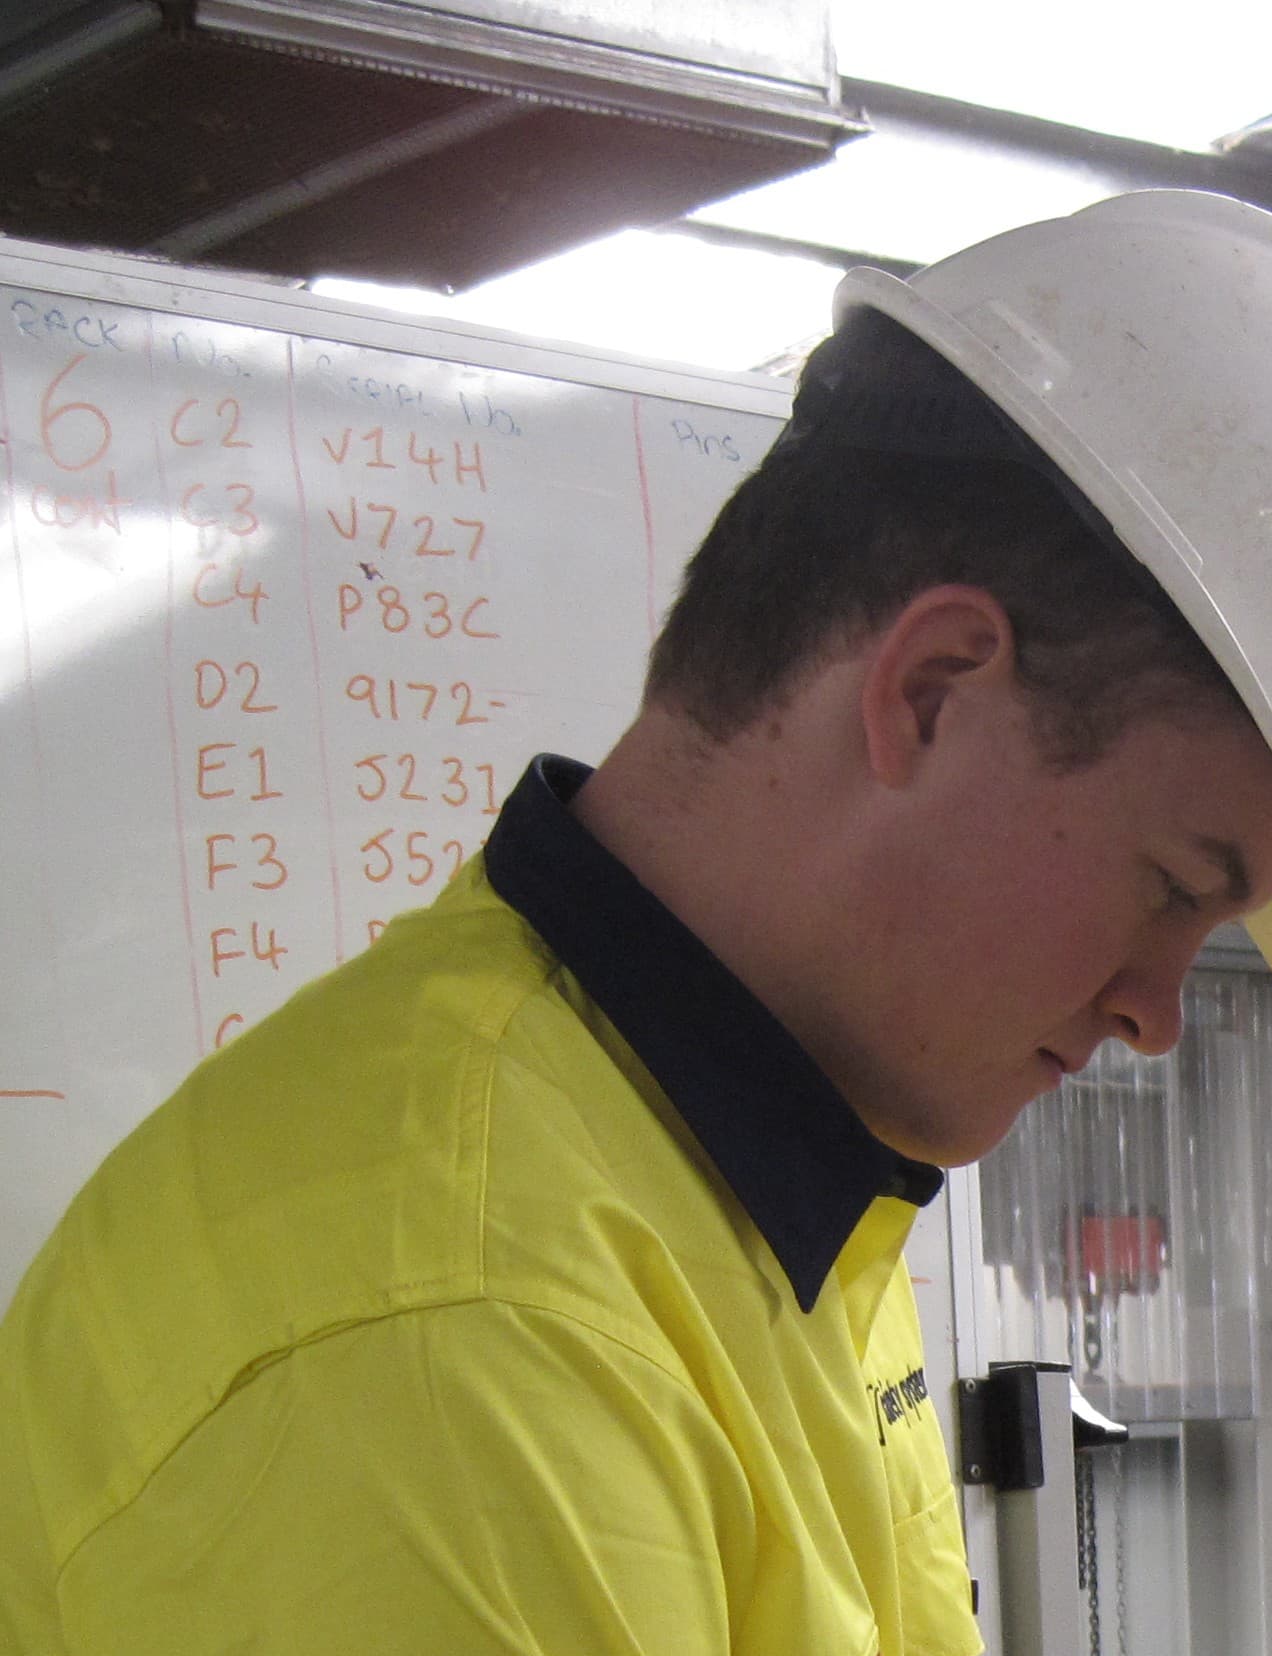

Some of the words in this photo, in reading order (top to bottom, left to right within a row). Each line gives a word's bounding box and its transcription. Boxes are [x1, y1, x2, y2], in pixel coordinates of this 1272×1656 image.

[41, 353, 112, 472] 6
[171, 398, 253, 448] C2
[322, 426, 487, 493] V14H
[182, 483, 259, 536] C3
[327, 497, 485, 561] V727
[194, 563, 270, 624] C4
[338, 583, 501, 639] P83C
[195, 659, 278, 713] D2
[198, 742, 284, 801] E1
[206, 832, 288, 890] F3
[210, 920, 289, 978] F4
